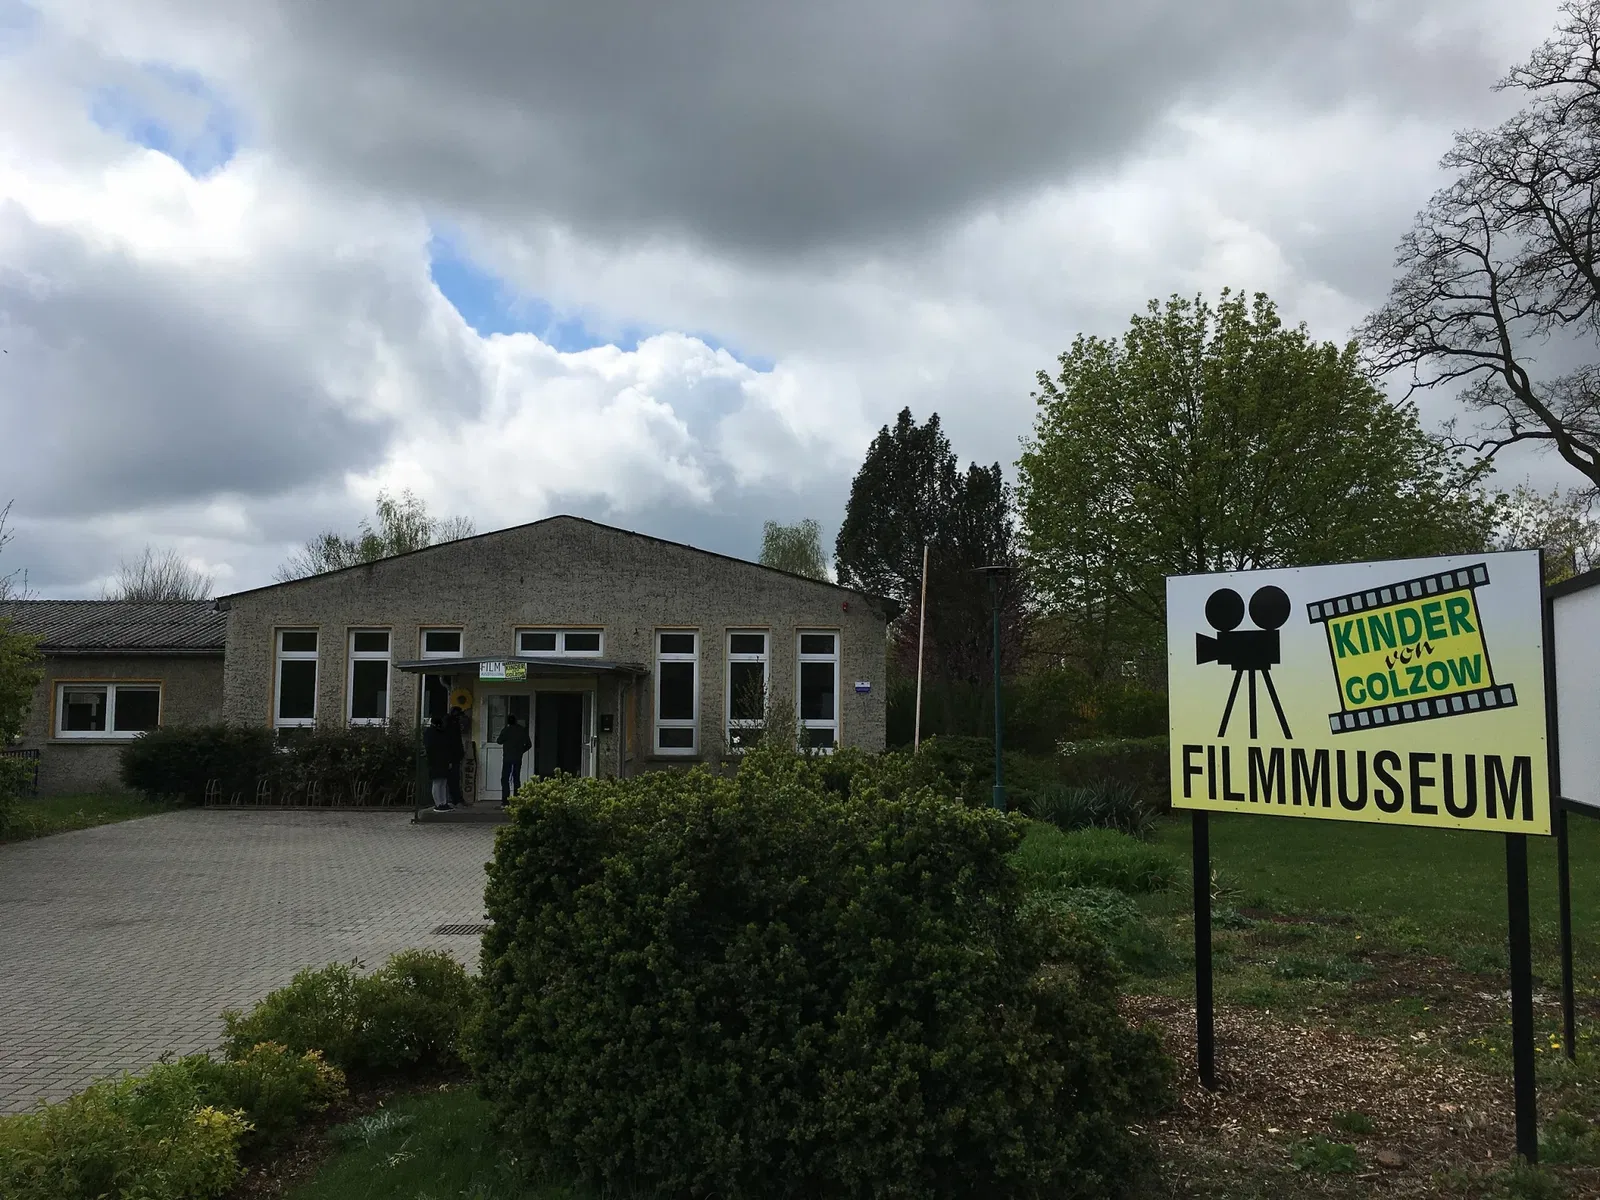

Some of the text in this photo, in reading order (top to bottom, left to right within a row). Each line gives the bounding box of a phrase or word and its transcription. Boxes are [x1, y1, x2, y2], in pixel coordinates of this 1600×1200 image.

[1332, 597, 1476, 658] KINDER
[481, 662, 501, 672] FILM
[1385, 641, 1434, 670] von
[1345, 654, 1481, 704] GOLZOW
[464, 759, 474, 793] OFFEN
[1182, 744, 1534, 821] FILMMUSEUM
